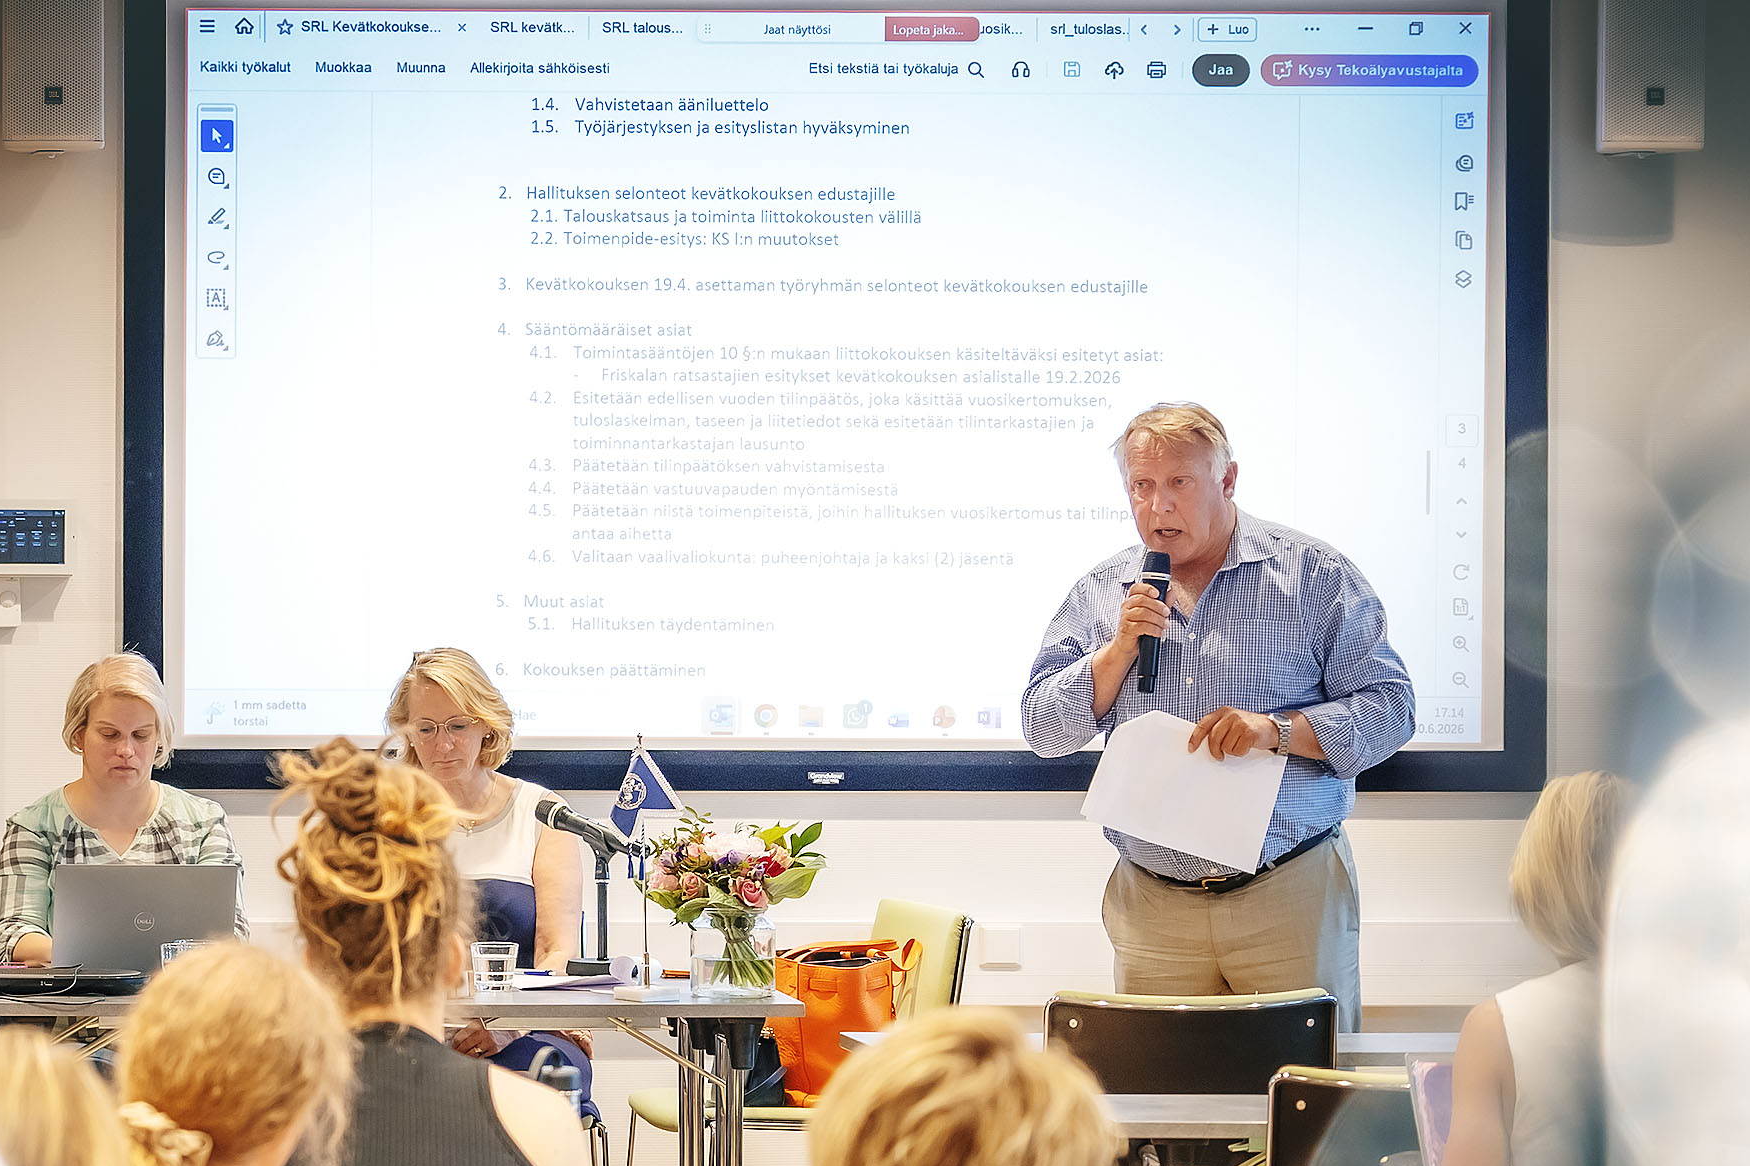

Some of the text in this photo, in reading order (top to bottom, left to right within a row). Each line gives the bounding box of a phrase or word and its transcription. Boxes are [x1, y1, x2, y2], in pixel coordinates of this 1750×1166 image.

[300, 20, 330, 33] SRL
[490, 21, 519, 33] SRL
[602, 21, 631, 34] SRL
[763, 24, 831, 38] Jaat näyttösi
[893, 24, 931, 38] Lopeta
[1228, 24, 1250, 35] Luo
[200, 60, 292, 76] Kaikki työkalut
[315, 61, 372, 73] Muokkaa
[396, 61, 446, 74] Muunna
[469, 61, 610, 77] Allekirjoita sähköisesti
[809, 62, 959, 77] Etsi tekstiä tai työkaluja
[1208, 63, 1234, 76] Jaa
[1298, 63, 1464, 79] Kysy Tekoälyavustajalta
[531, 96, 769, 112] 1.4. Vahvistetaan ääniluettelo
[531, 119, 910, 138] 1.5. Työjärjestyksen ja esityslistan hyväksyminen
[498, 185, 896, 205] 2. Hallituksen selonteot kevätkokouksen edustajille
[530, 208, 922, 227] 2.1. Talouskatsaus ja toiminta liittokokousten välillä
[530, 231, 839, 249] 2.2. Toimenpide-esitys: KS I:n muutokset
[498, 276, 1149, 297] 3. Kevätkokouksen 19.4. asettaman työryhmän selonteot kevätkokouksen edustajille
[497, 322, 693, 337] 4. Sääntömääräiset asiat
[529, 344, 1163, 365] 4.1. Toimintasääntöjen 10 §:n mukaan liittokokouksen käsiteltäväksi esitetyt asiat:
[601, 367, 1121, 386] Friskalan ratsastajien esitykset kevätkokouksen asialistalle 19.2.2026
[529, 390, 1112, 409] 4.2. Esitetään edellisen vuoden tilinpäätös, joka käsittää vuosikertomuksen,
[572, 412, 1095, 433] tuloslaskelman, taseen ja liitetiedot sekä esitetään tilintarkastajien ja
[1457, 422, 1467, 435] 3
[572, 435, 805, 454] toiminnantarkastajan lausunto
[528, 457, 885, 476] 4.3. Päätetään tilinpäätöksen vahvistamisesta
[1457, 456, 1467, 470] 4
[528, 480, 899, 499] 4.4. Päätetään vastuuvapauden myöntämisestä
[527, 503, 1134, 523] 4.5. Päätetään niistä toimenpiteistä, joihin hallituksen vuosikertomus tai tilinp
[571, 526, 672, 541] antaa aihetta
[527, 548, 1014, 569] 4.6. Valitaan vaalivaliokunta: puheenjohtaja ja kaksi (2) jäsentä
[496, 593, 605, 609] 5. Muut asiat
[527, 615, 775, 635] 5.1. Hallituksen täydentäminen
[495, 662, 706, 680] 6. Kokouksen päättäminen
[241, 702, 263, 710] mm
[265, 699, 307, 711] sadetta
[1434, 706, 1465, 719] 17.14
[233, 715, 269, 727] torstai
[1415, 723, 1465, 735] 0.6.2026
